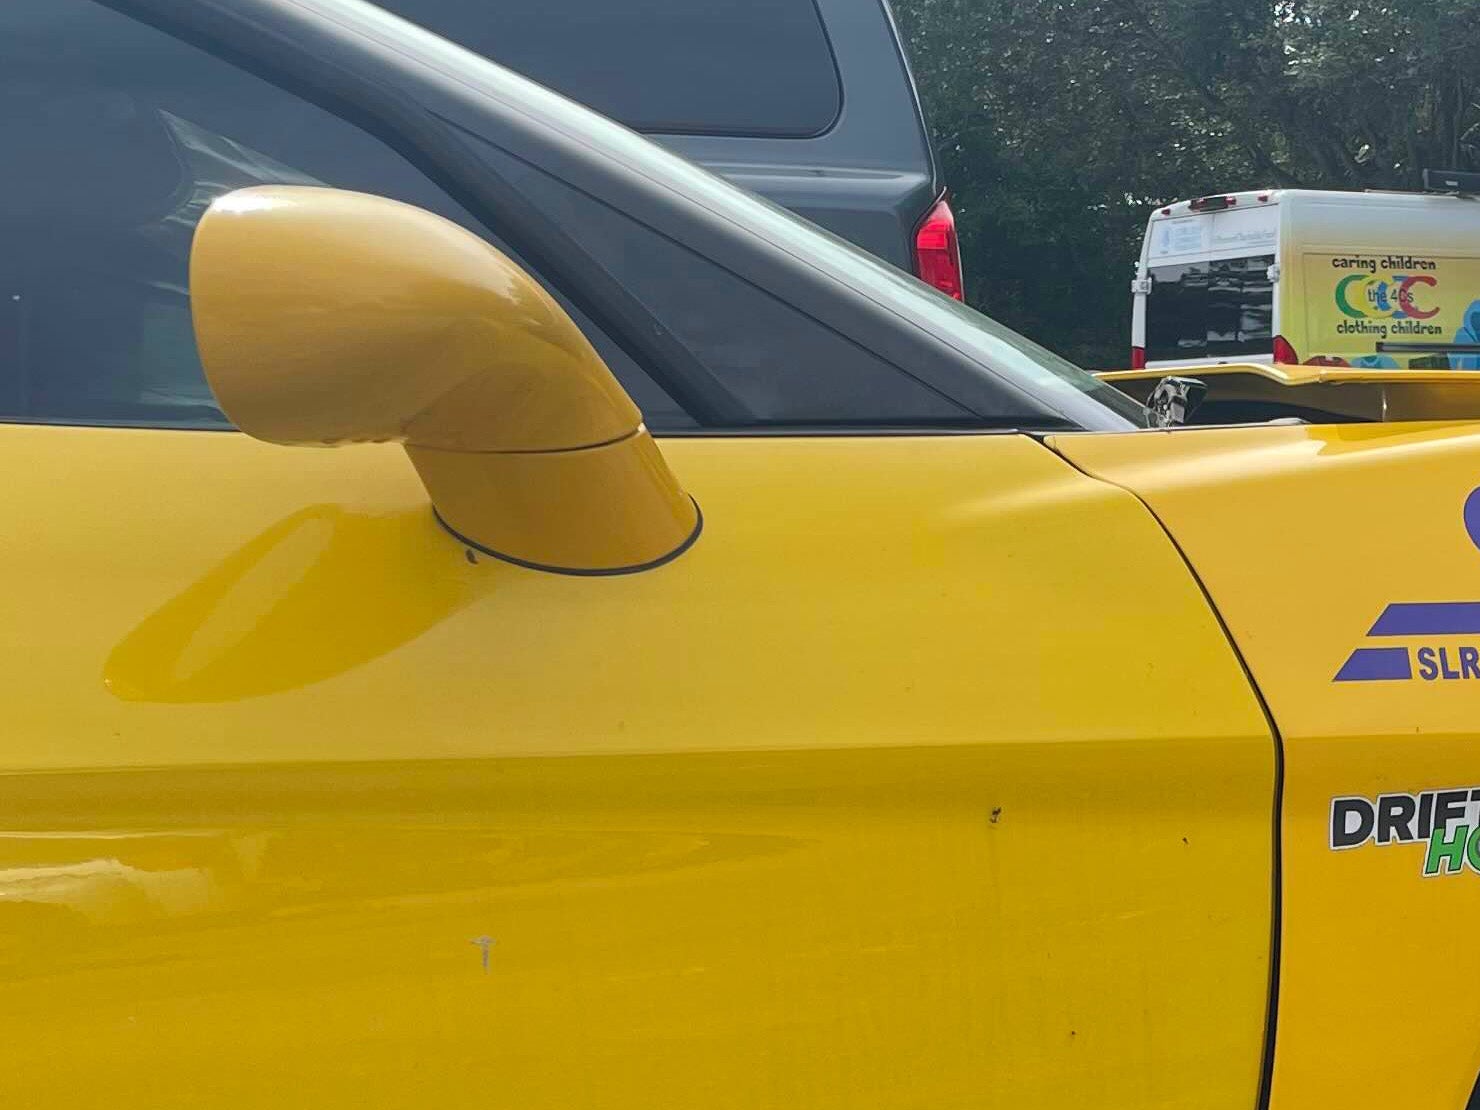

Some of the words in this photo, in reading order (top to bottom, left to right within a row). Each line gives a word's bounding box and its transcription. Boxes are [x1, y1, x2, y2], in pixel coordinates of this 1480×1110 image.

[1332, 255, 1376, 273] caring
[1380, 255, 1436, 270] children
[1368, 288, 1387, 302] the
[1337, 320, 1387, 339] clothing
[1391, 320, 1442, 334] children
